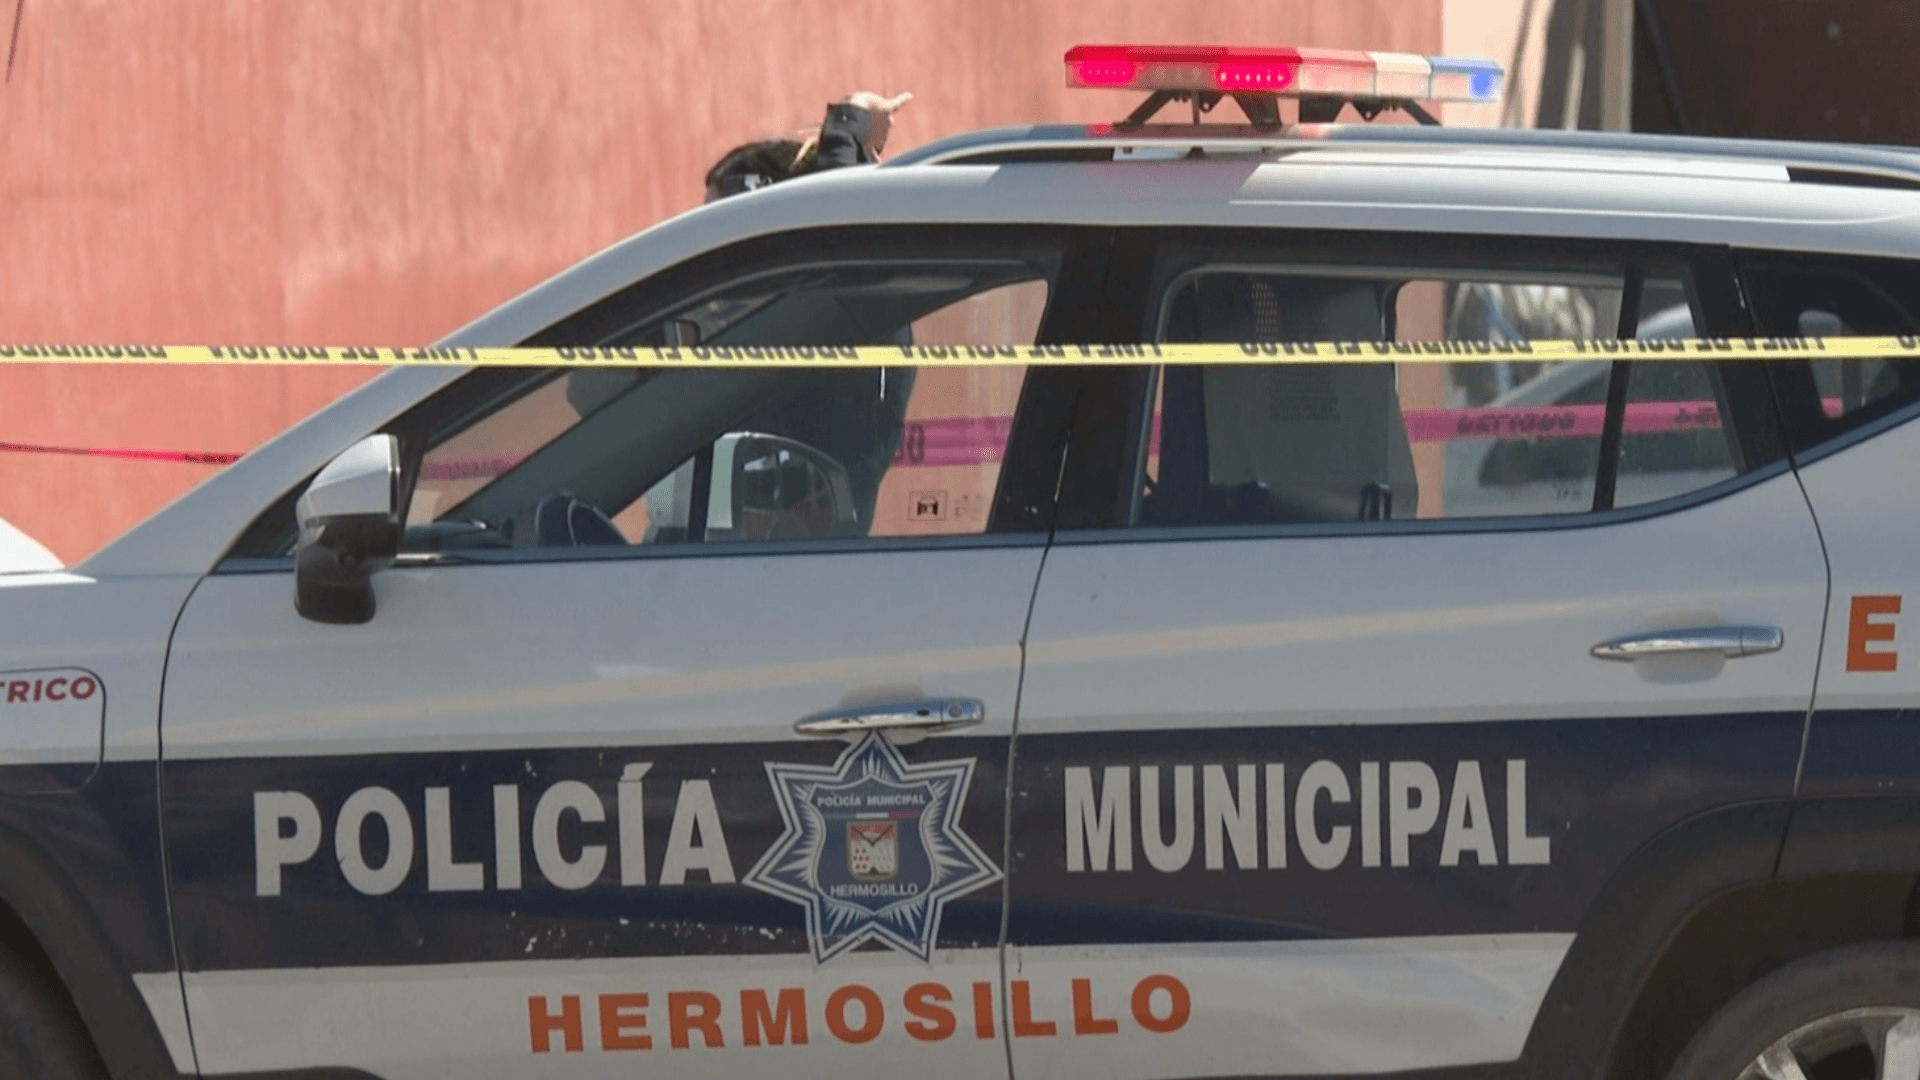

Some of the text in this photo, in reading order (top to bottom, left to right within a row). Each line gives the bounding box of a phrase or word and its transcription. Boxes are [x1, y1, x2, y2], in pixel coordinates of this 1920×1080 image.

[0, 676, 97, 703] RICO
[817, 794, 926, 808] POLICÍA MUNICIPAL
[254, 759, 1552, 896] POLICÍA MUNICIPAL
[830, 882, 919, 898] HERMOSILLO
[528, 973, 1192, 1055] HERMOSILLO
